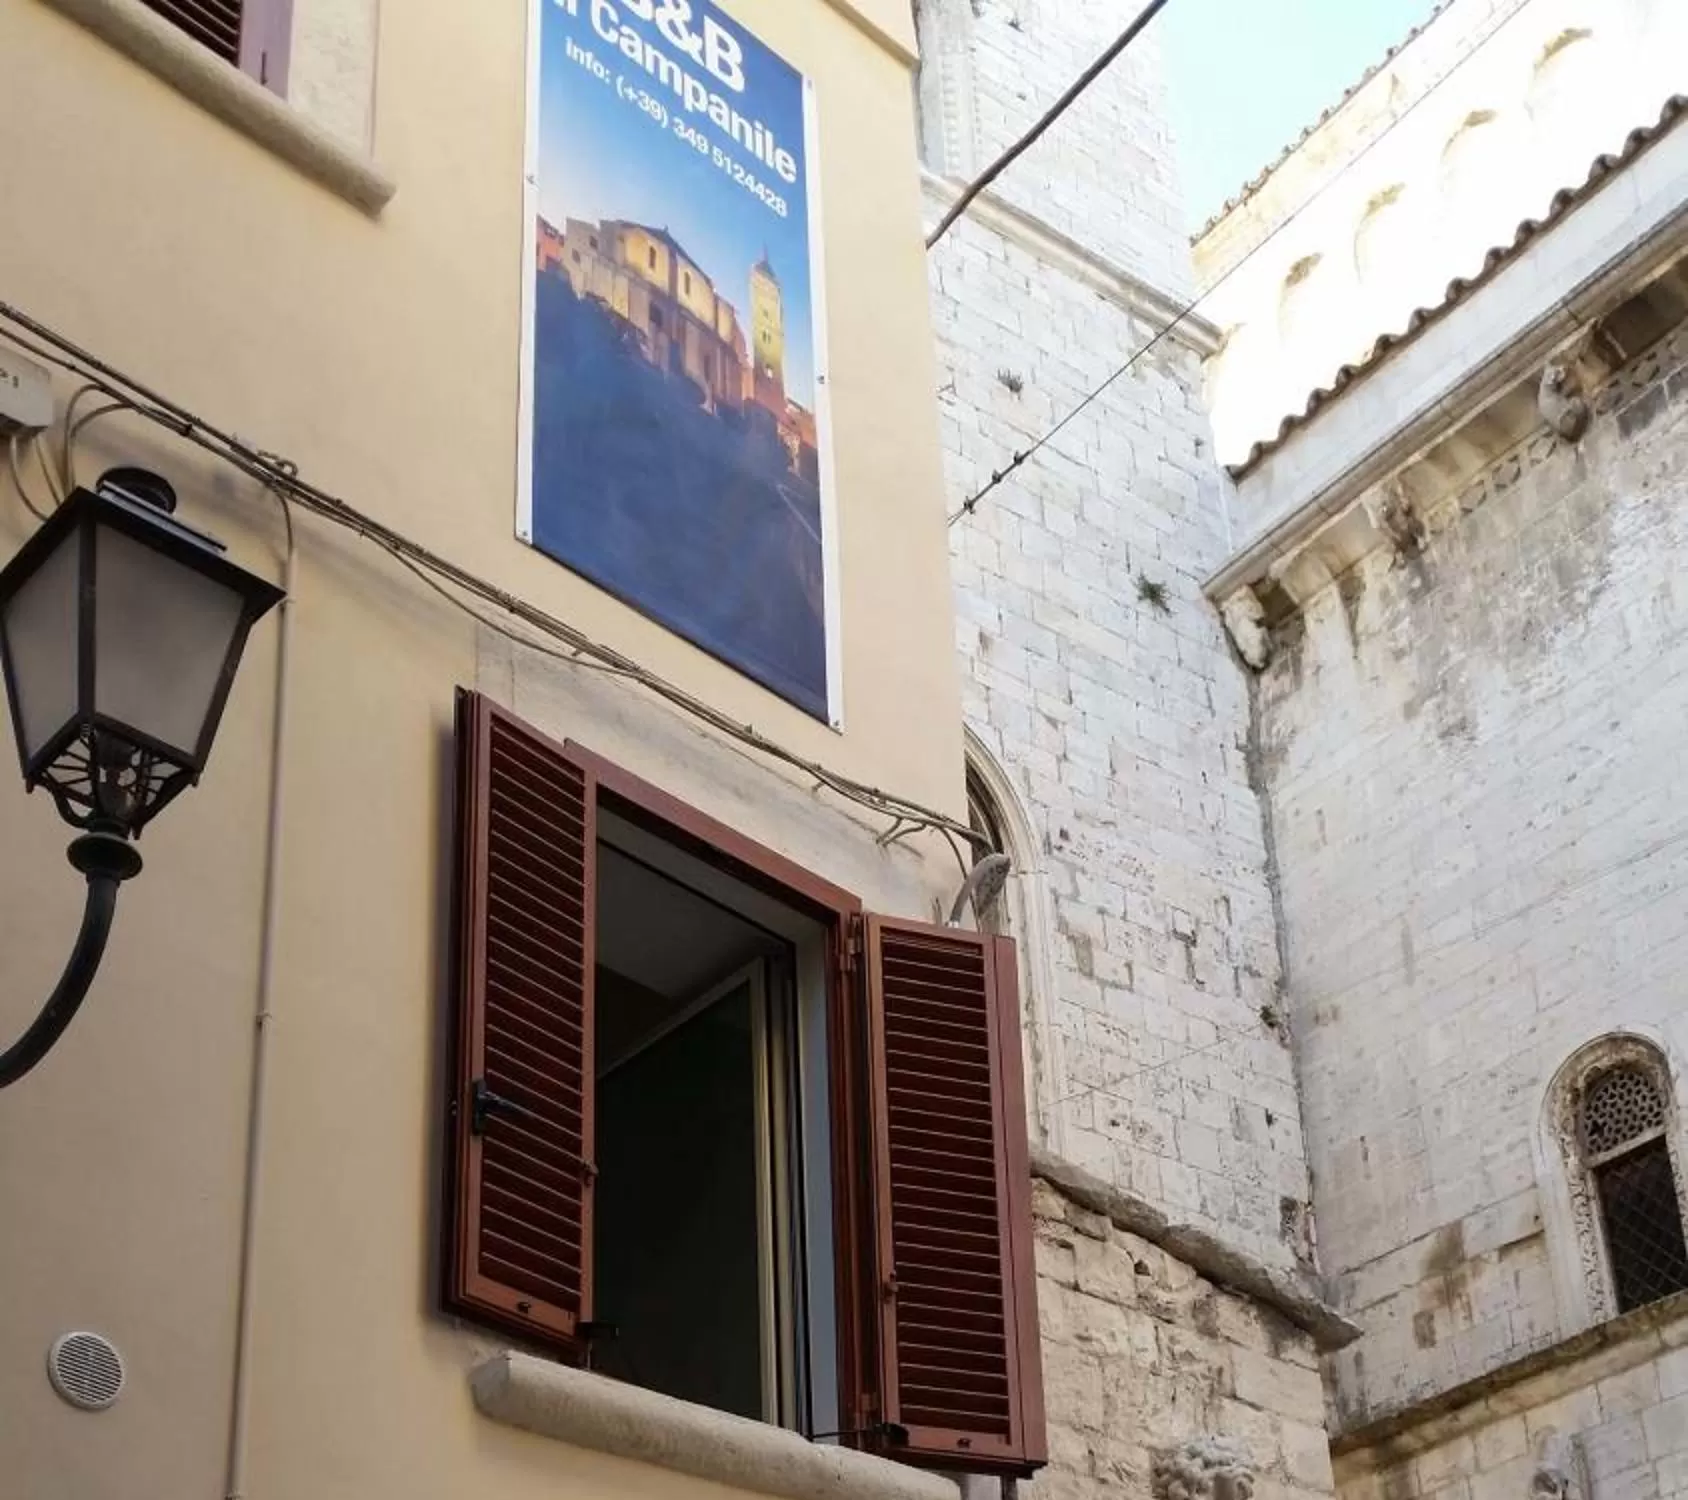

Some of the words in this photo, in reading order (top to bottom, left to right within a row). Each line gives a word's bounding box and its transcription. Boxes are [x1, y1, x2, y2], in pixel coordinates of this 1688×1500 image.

[591, 0, 797, 184] Campanile
[616, 75, 669, 128] (+39)
[673, 117, 708, 155] 349
[712, 145, 788, 217] 5124428
